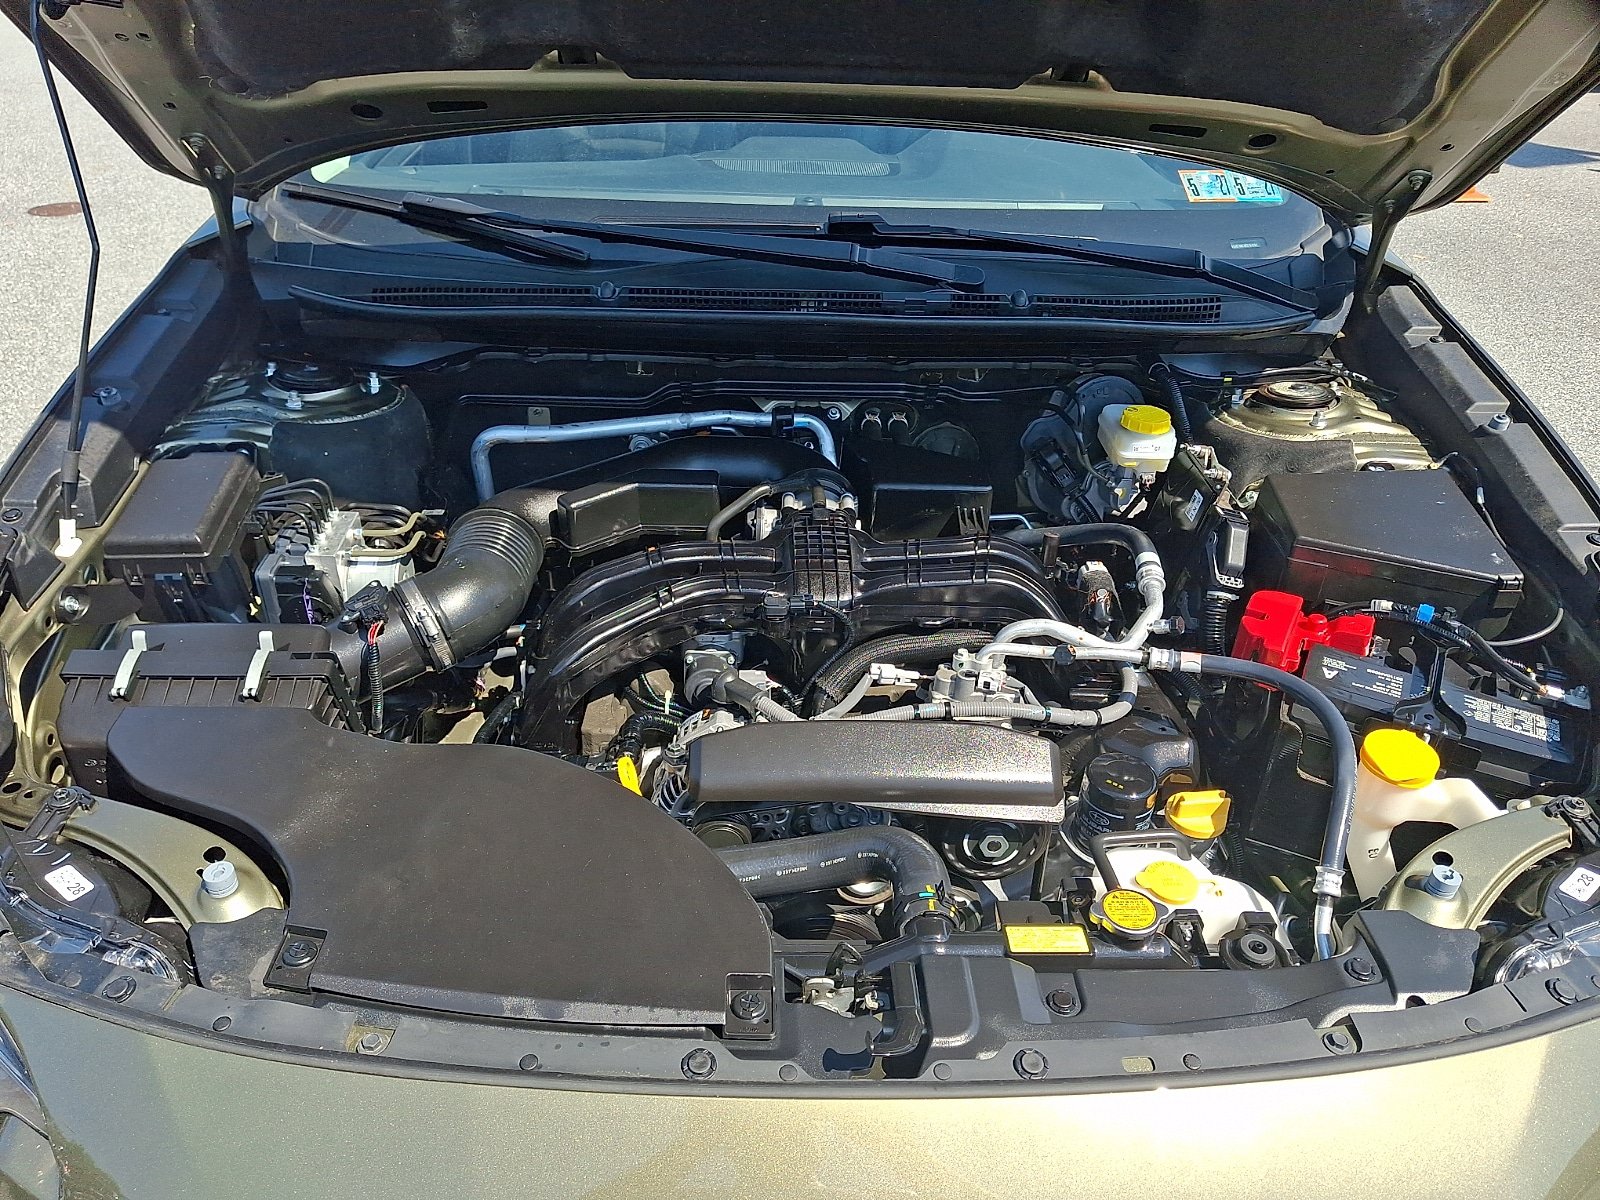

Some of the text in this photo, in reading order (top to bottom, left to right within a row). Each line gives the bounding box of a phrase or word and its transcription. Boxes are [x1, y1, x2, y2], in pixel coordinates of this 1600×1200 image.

[1187, 177, 1200, 197] 5
[1215, 174, 1231, 196] 27
[1233, 176, 1246, 196] 5
[1081, 813, 1113, 833] SUBAR
[66, 882, 86, 896] 28
[1577, 873, 1595, 887] 28
